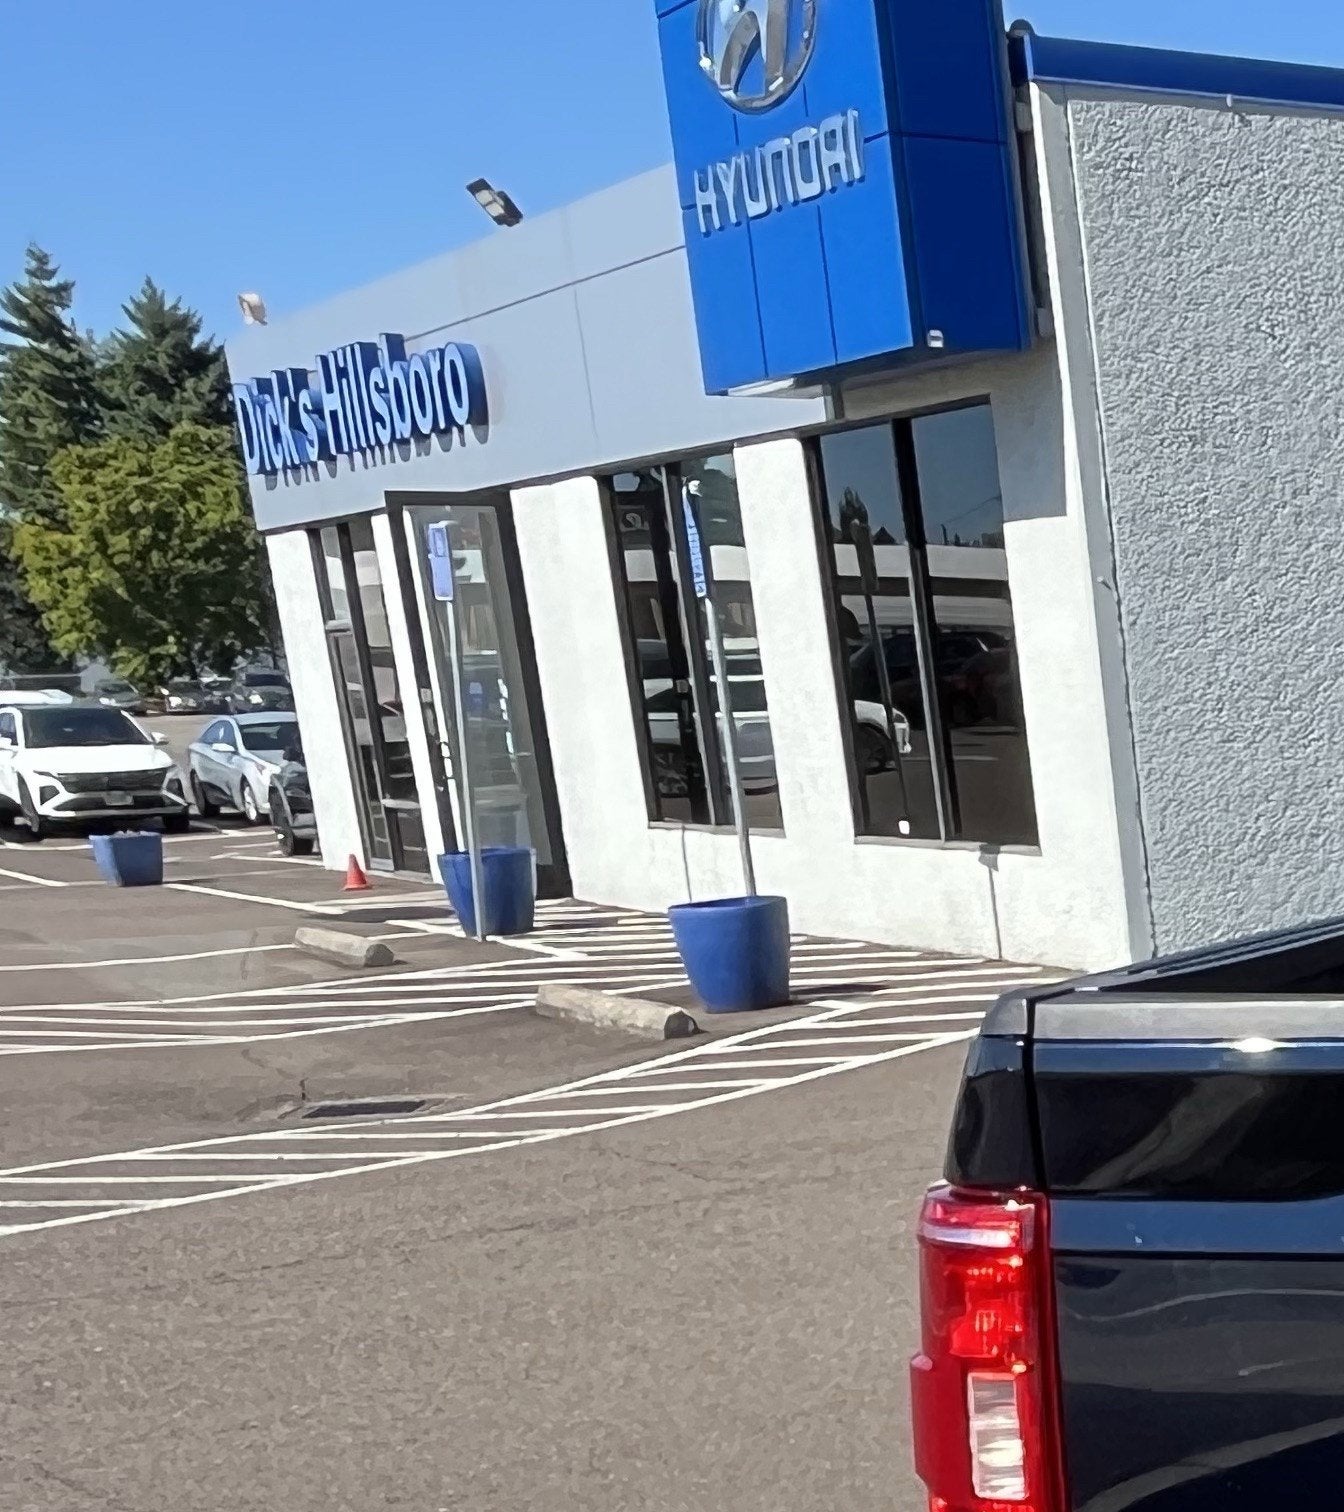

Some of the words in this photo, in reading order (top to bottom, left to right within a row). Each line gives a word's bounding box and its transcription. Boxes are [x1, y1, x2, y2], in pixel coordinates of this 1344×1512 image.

[694, 108, 860, 234] HYUNDAI
[232, 368, 319, 475] Dick's
[315, 332, 471, 456] Hillsboro
